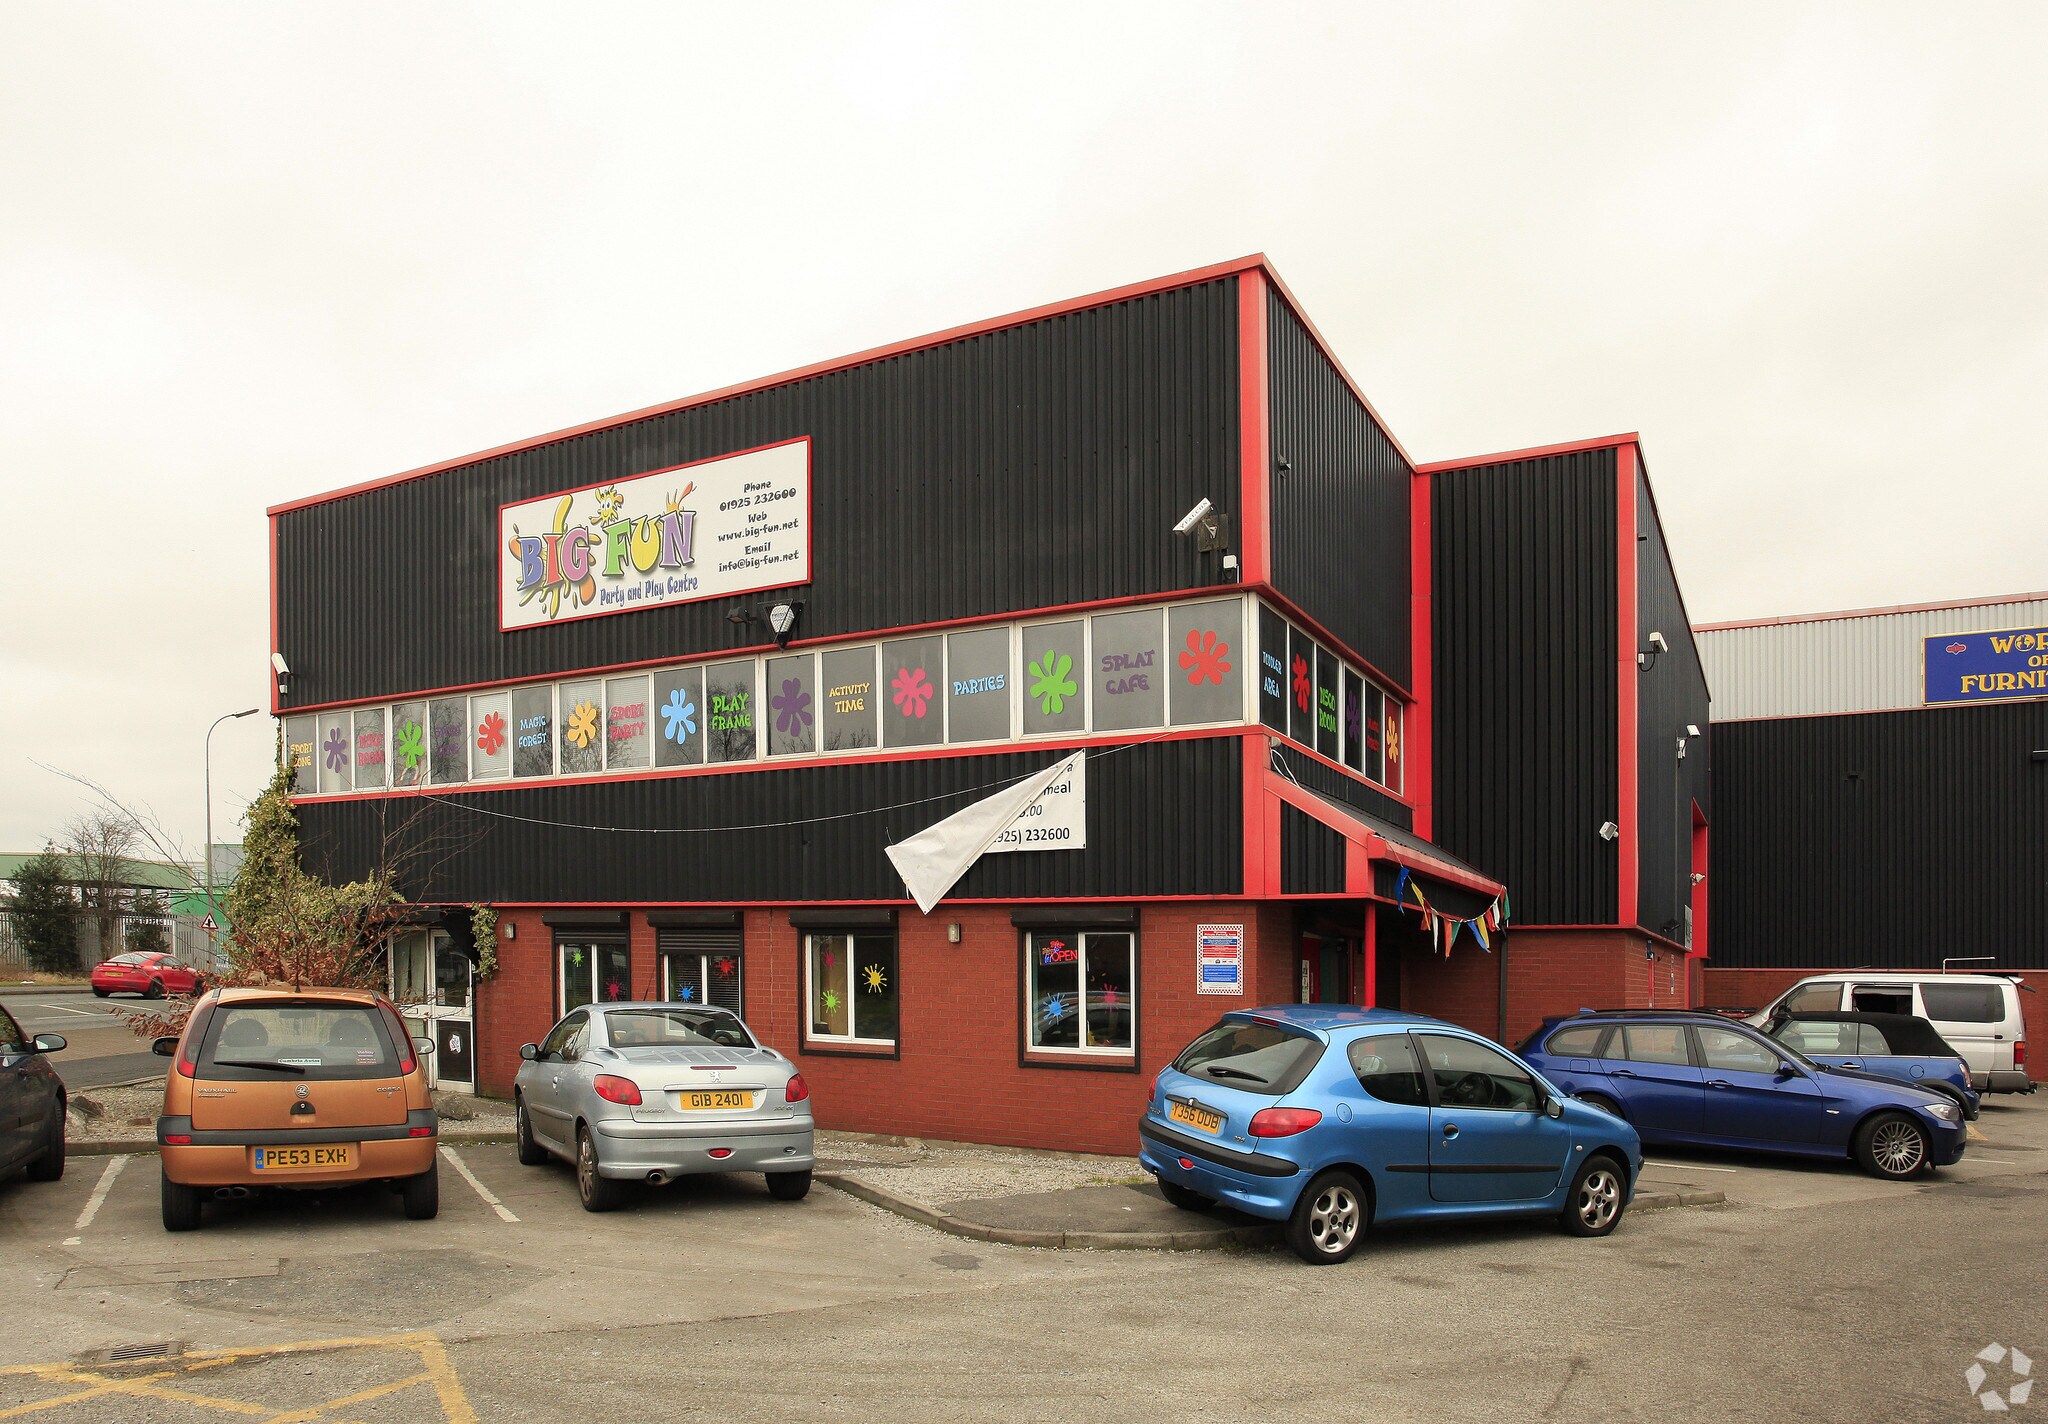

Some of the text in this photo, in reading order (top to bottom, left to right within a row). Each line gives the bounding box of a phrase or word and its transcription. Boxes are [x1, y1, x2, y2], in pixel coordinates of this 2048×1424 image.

[743, 481, 772, 493] Phone
[719, 487, 797, 511] 01925 232600
[748, 511, 767, 523] Web
[718, 518, 799, 542] www.big-fun.net
[517, 511, 697, 590] BIG FUN
[745, 541, 771, 555] Email
[719, 550, 799, 572] info@big-fun.net
[600, 573, 698, 607] Party and Play Centre
[1101, 649, 1154, 673] SPLAT
[828, 682, 870, 698] ACTIVITY
[953, 674, 1006, 696] PARTIES
[1105, 674, 1150, 695] CAFE
[1263, 676, 1280, 699] AREA
[1960, 670, 2048, 693] FURNI
[712, 692, 750, 713] PLAY
[834, 698, 865, 714] TIME
[1319, 686, 1336, 712] DISCO
[610, 703, 644, 720] SPORT
[1318, 708, 1337, 733] ROOM
[520, 715, 546, 731] MAGIC
[609, 722, 646, 740] PARTY
[711, 713, 752, 731] FRAME
[290, 742, 313, 755] SPORT
[518, 732, 547, 748] FOREST
[994, 827, 1070, 844] 925) 232600
[1052, 949, 1078, 962] OPEN
[691, 1093, 743, 1107] GIB 2401
[266, 1148, 347, 1165] PE53 EXH
